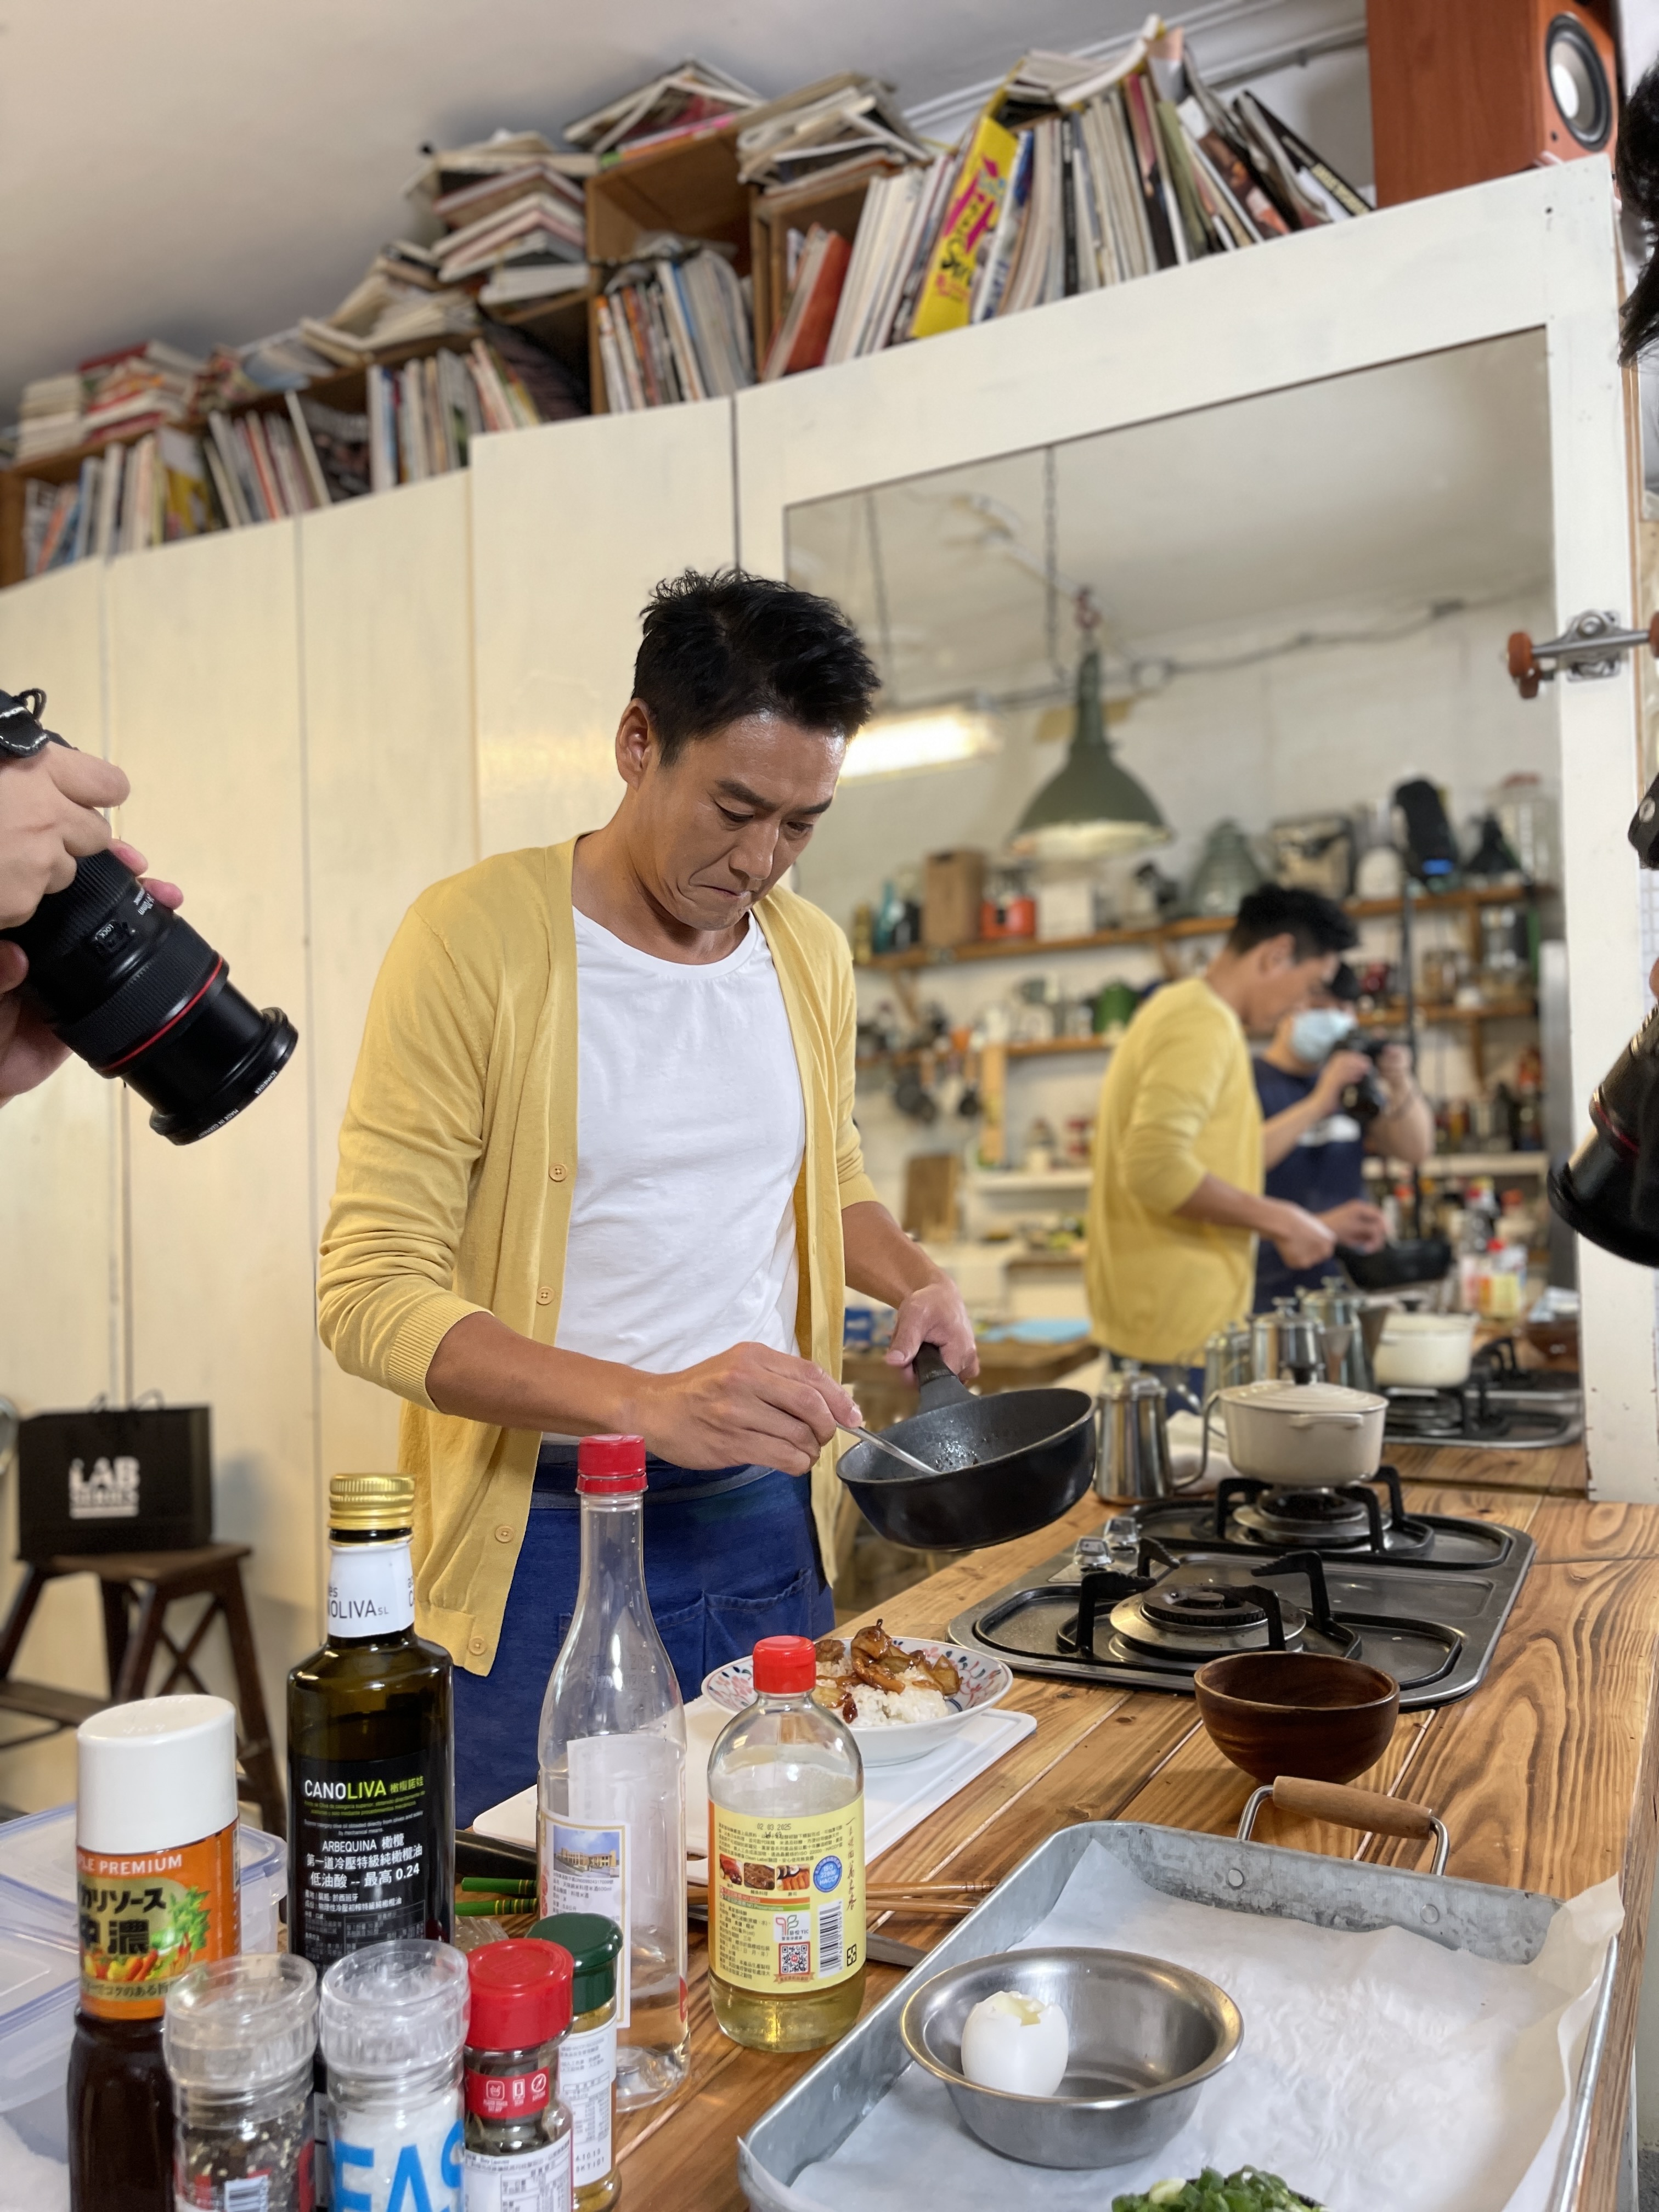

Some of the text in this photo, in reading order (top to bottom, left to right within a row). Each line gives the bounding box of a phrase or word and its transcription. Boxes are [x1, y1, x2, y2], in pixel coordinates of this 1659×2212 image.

[99, 924, 114, 939] LOCK
[224, 1108, 239, 1121] MADE
[69, 1457, 140, 1491] LAB
[304, 1779, 387, 1799] CANOLIVA
[321, 1833, 404, 1853] ARBEQUINA 橄欖
[98, 1854, 183, 1876] PREMIUM
[306, 1843, 423, 1870] 第一道冷壓特級純橄欖油
[310, 1871, 348, 1889] 低油酸
[364, 1869, 392, 1887] 最高
[396, 1863, 420, 1881] 0.24
[819, 1874, 839, 1886] HACCP
